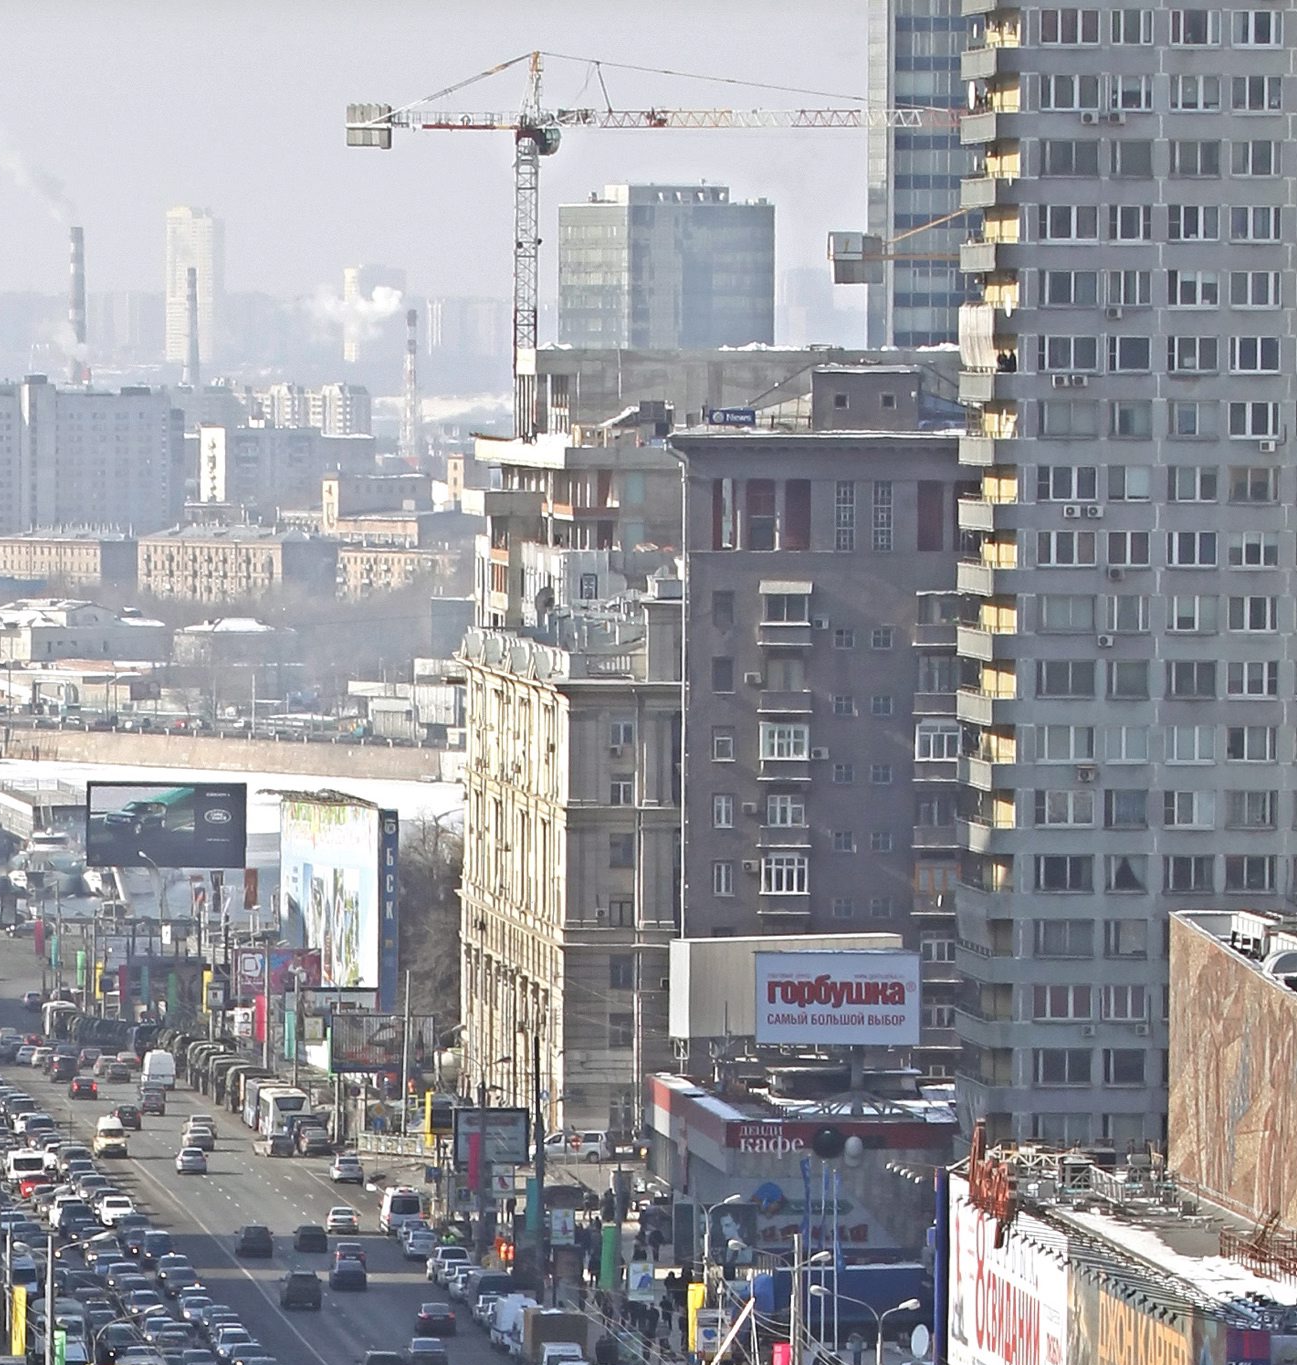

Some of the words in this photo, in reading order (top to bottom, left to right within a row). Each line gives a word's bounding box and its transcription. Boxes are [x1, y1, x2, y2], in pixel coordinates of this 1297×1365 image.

[767, 1012, 808, 1025] САМЫЙ
[811, 1012, 865, 1026] БОЛЬШОЙ
[868, 1014, 906, 1026] ВЫБОР
[740, 1136, 804, 1160] кафе
